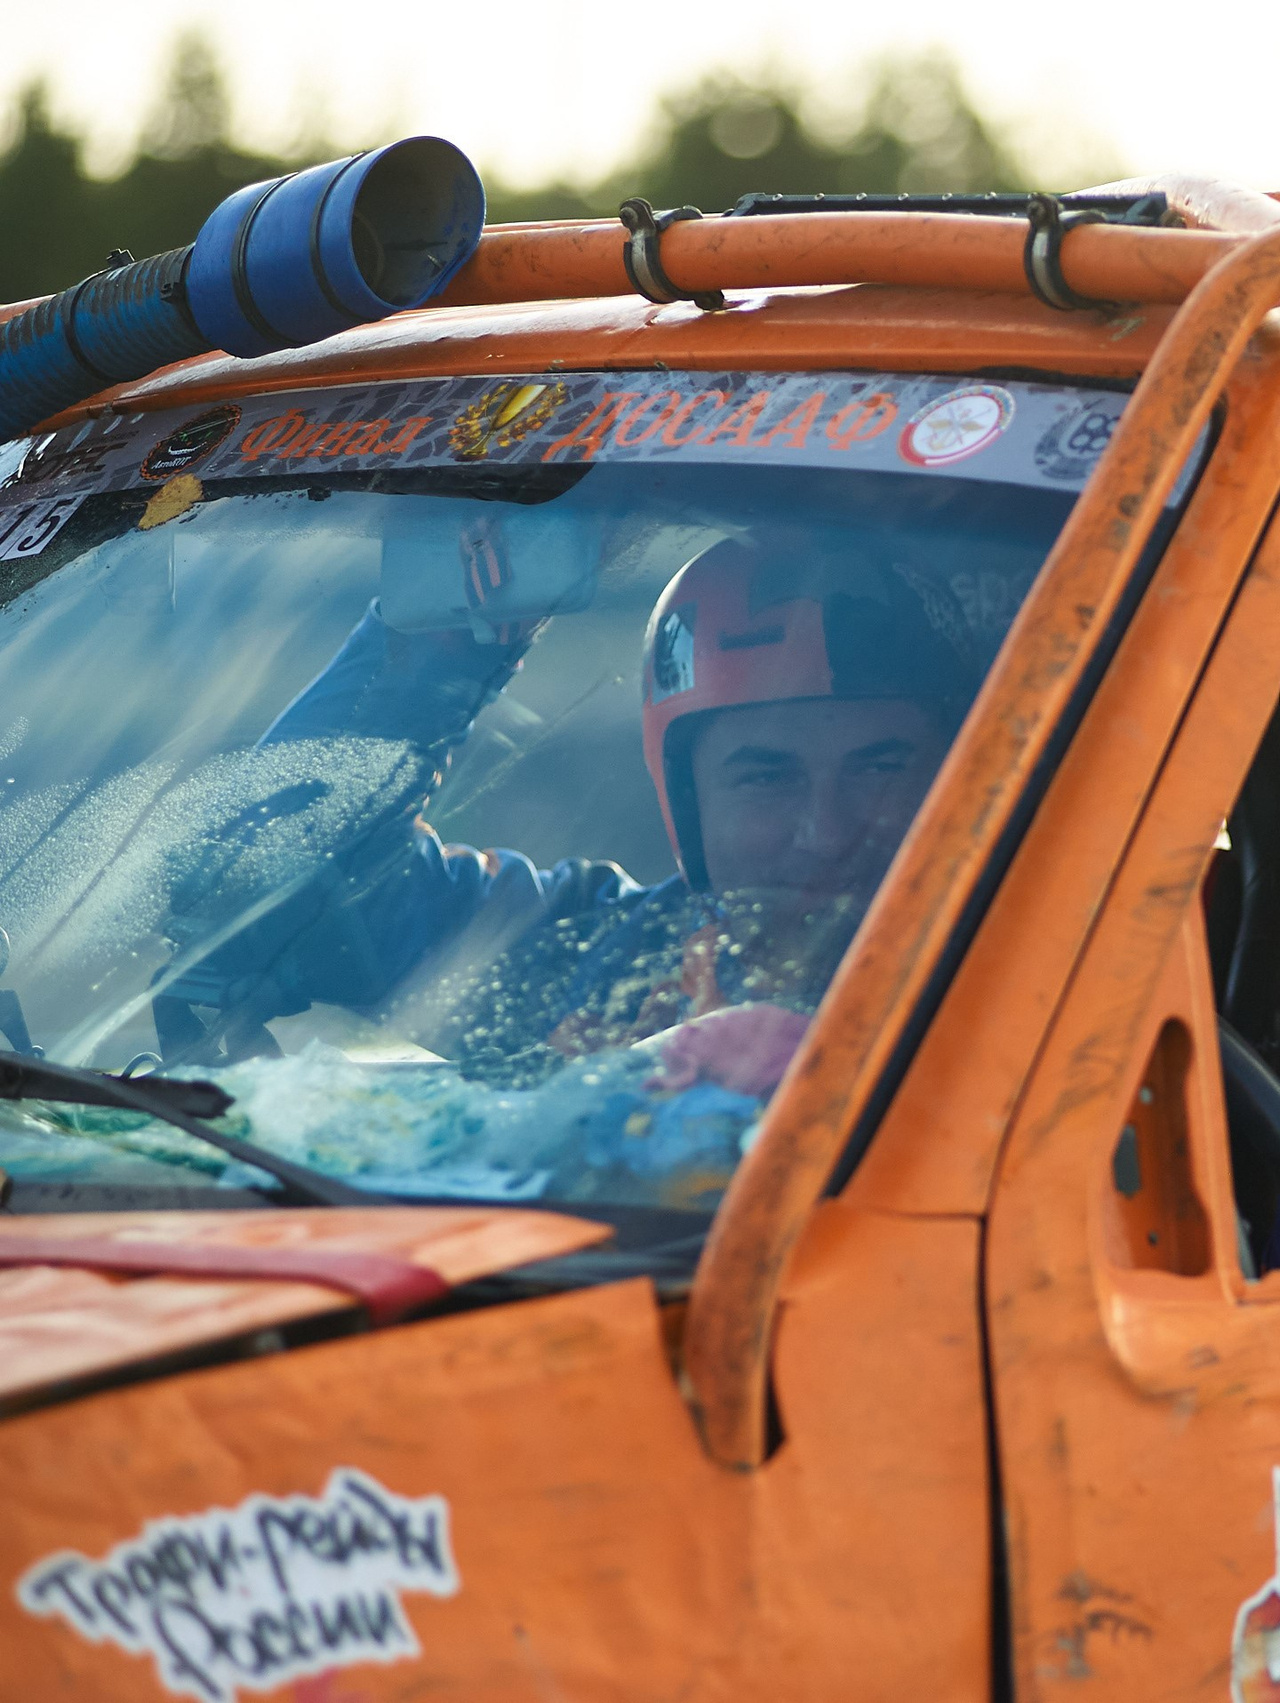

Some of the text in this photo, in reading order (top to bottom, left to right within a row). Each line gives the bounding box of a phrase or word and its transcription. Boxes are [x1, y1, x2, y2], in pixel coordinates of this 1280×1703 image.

[240, 390, 899, 462] Финал ДОСААФ
[150, 1590, 408, 1701] России
